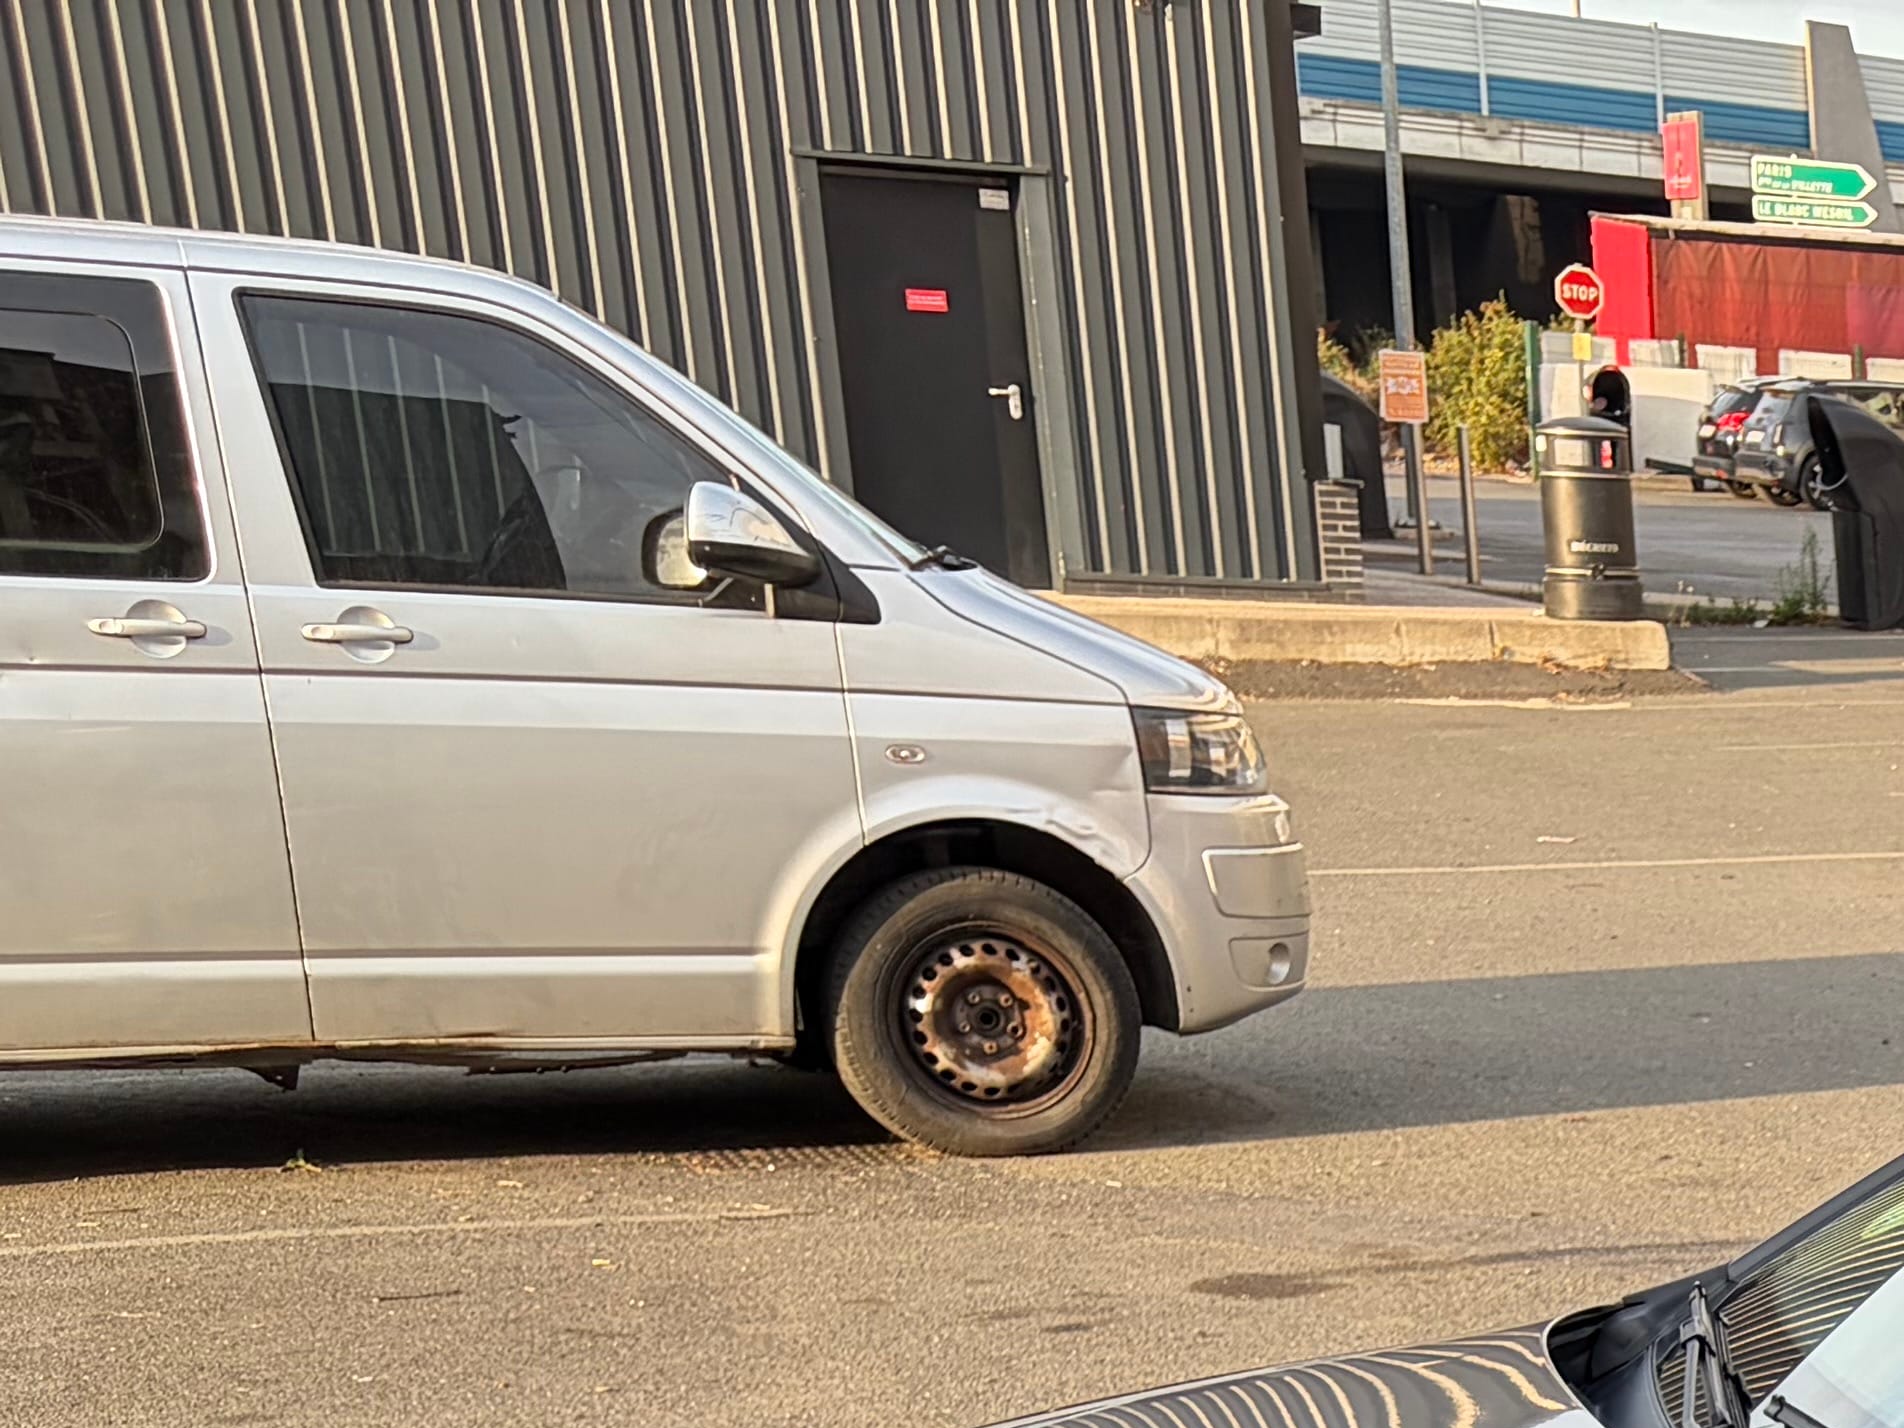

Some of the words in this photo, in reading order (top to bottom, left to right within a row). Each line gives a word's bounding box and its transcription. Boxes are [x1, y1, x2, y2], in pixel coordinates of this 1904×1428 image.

[1757, 162, 1792, 179] PARIS
[1791, 179, 1833, 194] VILLETTE
[1759, 201, 1772, 215] LE
[1774, 203, 1811, 218] BLANC
[1562, 283, 1599, 302] STOP
